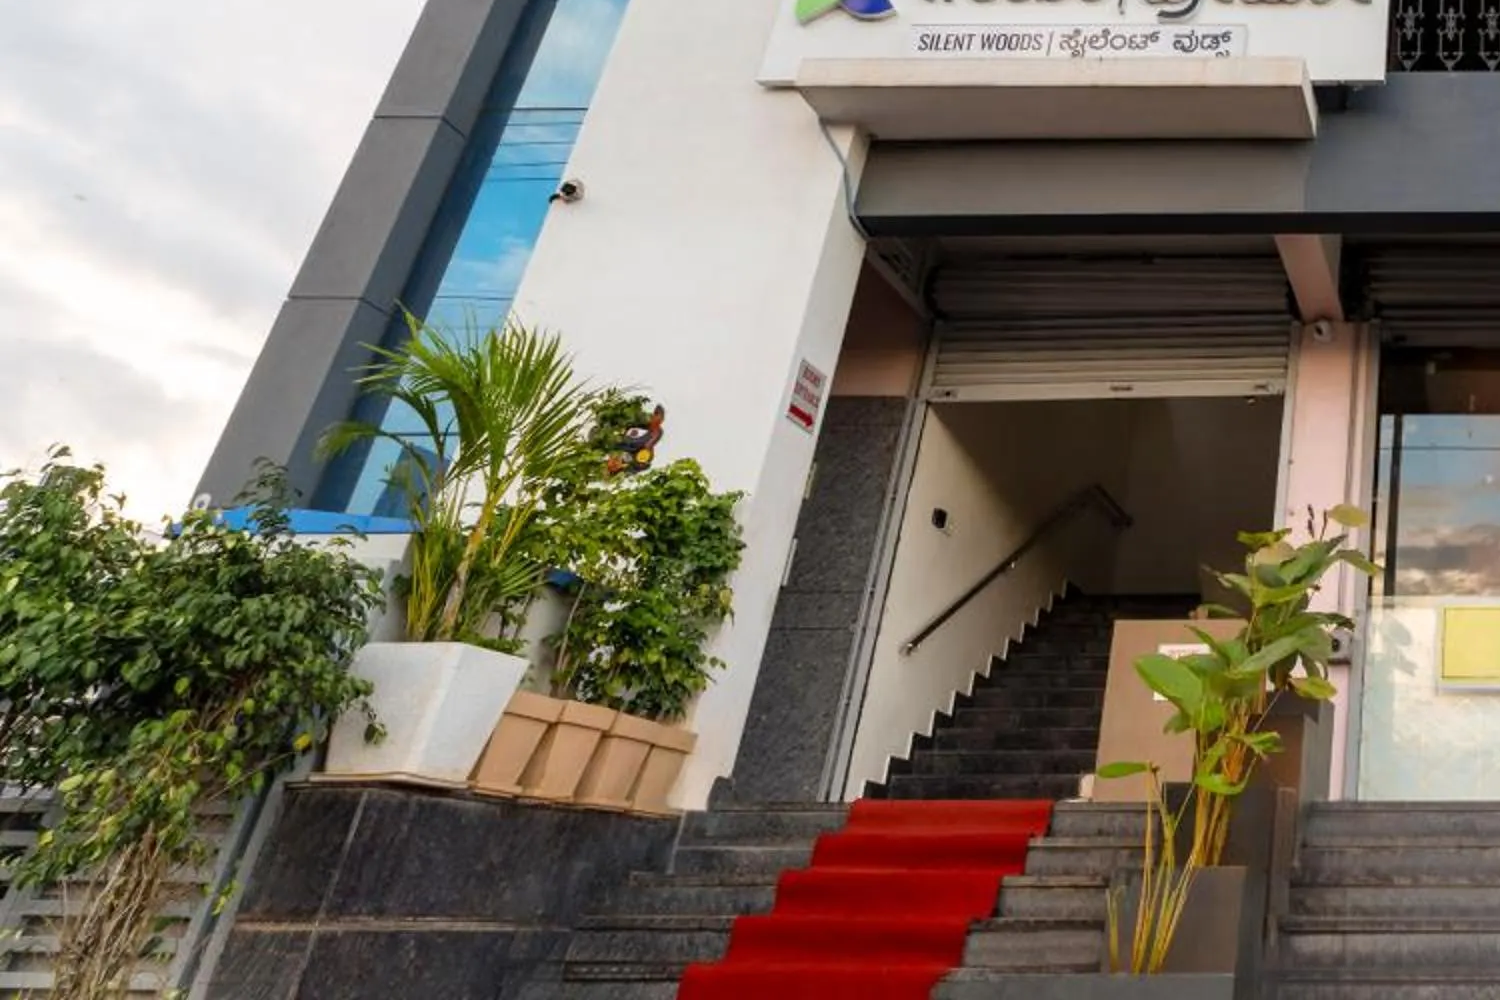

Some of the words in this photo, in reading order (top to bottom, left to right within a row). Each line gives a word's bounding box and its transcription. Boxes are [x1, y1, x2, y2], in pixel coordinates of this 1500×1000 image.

[917, 33, 976, 51] SILENT
[980, 32, 1044, 51] WOODS
[1059, 27, 1161, 58] ಸೈಲೆಂಟ್
